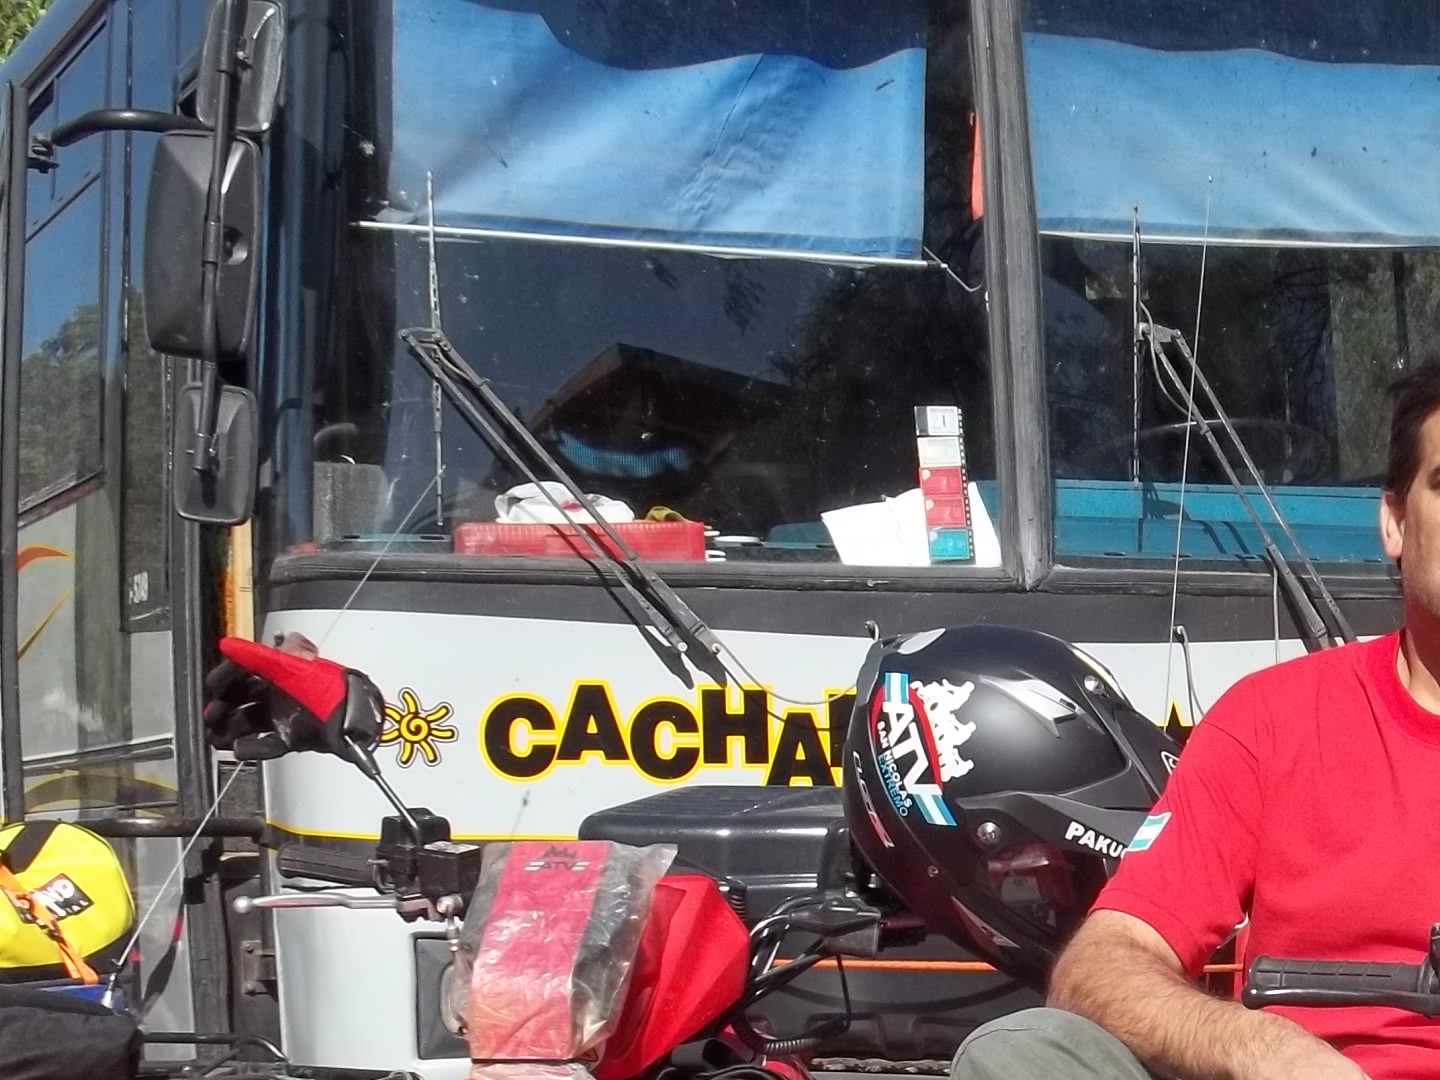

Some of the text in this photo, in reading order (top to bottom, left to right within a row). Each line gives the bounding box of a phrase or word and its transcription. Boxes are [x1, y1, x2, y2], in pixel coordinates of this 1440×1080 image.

[878, 752, 910, 818] EXTREMO
[884, 749, 914, 808] NICOLAS
[1064, 821, 1124, 859] PAKU
